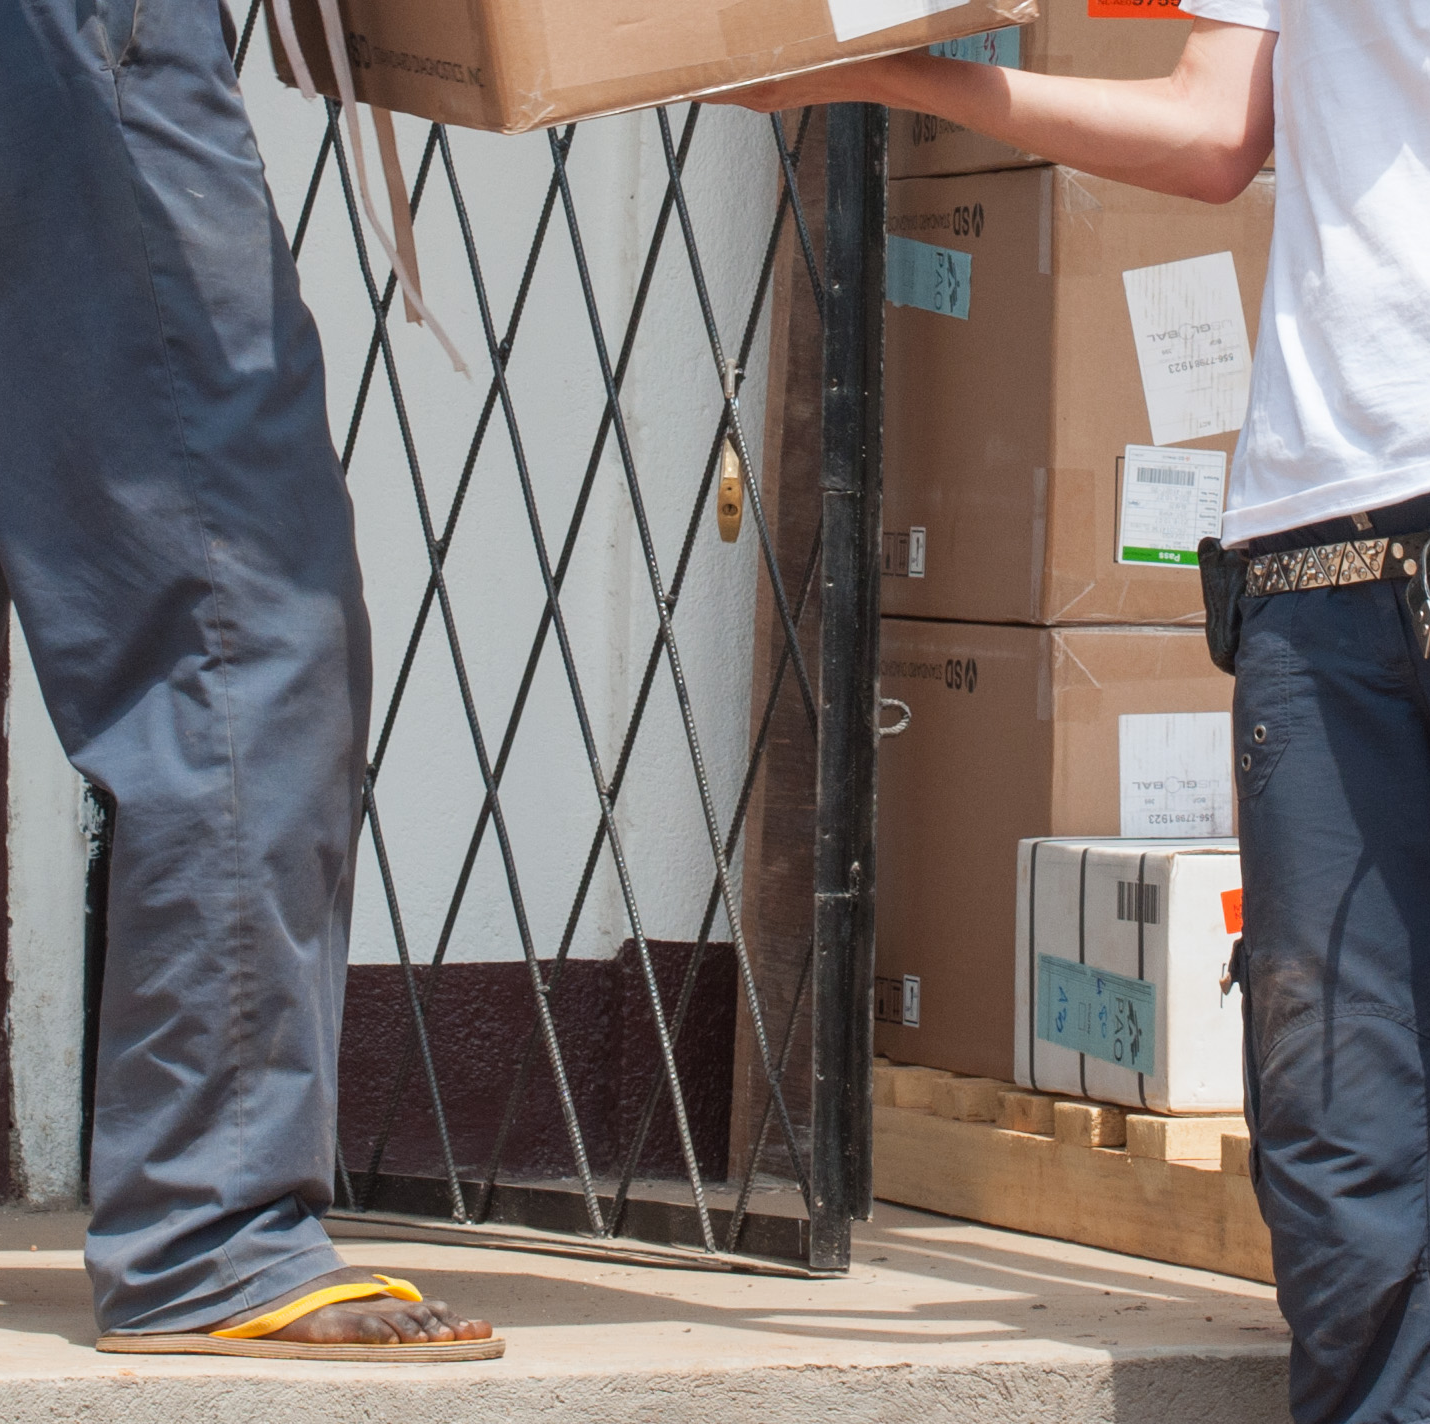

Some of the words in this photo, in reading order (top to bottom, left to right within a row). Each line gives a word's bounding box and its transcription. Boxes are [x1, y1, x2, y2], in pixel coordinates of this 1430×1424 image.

[953, 206, 970, 236] SD
[934, 252, 945, 311] PAO
[1158, 551, 1181, 562] Pass
[945, 659, 963, 690] SD
[1113, 997, 1125, 1062] PAO
